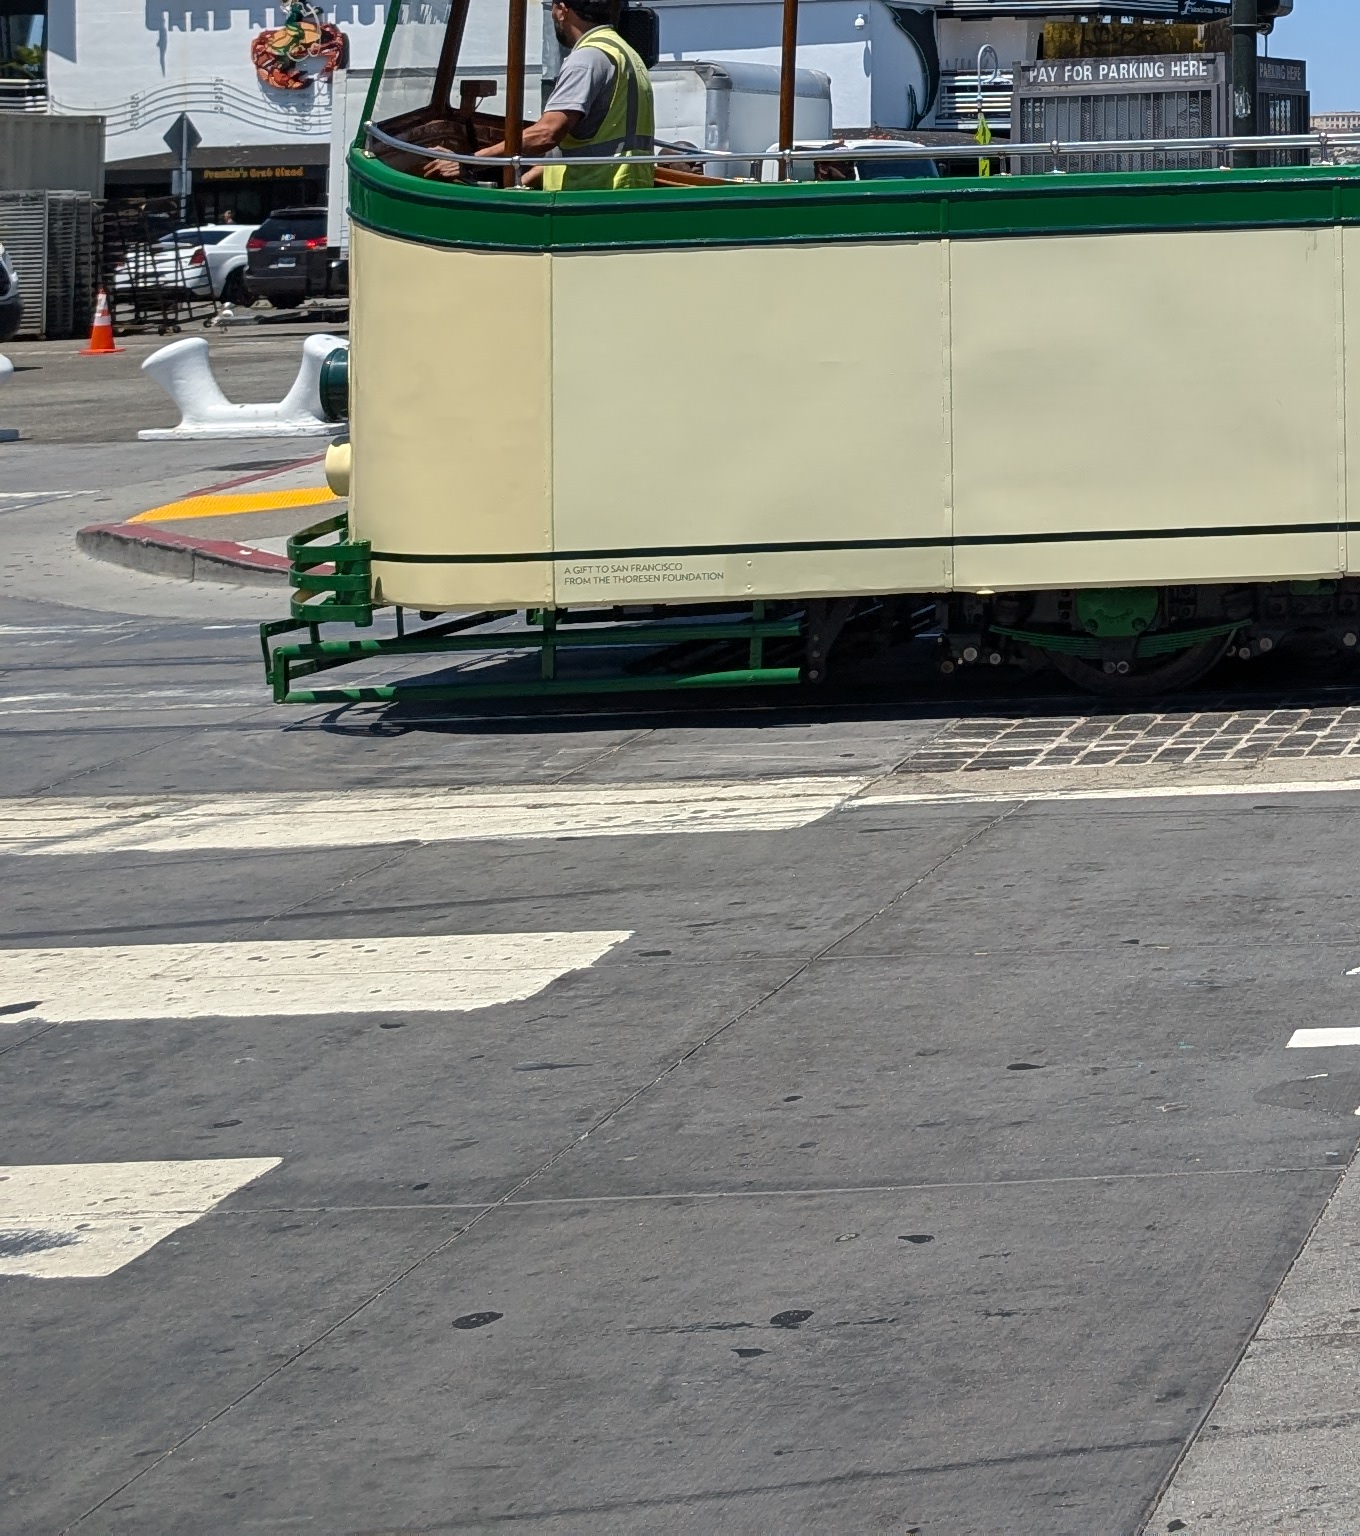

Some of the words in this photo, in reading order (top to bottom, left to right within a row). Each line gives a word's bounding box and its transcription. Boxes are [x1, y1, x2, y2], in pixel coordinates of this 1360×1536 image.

[1029, 67, 1057, 83] PAY
[1064, 65, 1092, 81] FOR
[1099, 62, 1164, 80] PARKING
[1171, 60, 1208, 77] HERE
[564, 567, 571, 575] A
[573, 566, 593, 574] GIFT
[596, 565, 609, 574] TO
[611, 564, 629, 573] SAN
[630, 563, 683, 572] FRANCISCO
[564, 577, 591, 585] FROM
[594, 576, 611, 584] THE
[614, 574, 661, 584] THORESEN
[663, 572, 724, 582] FOUNDATION
